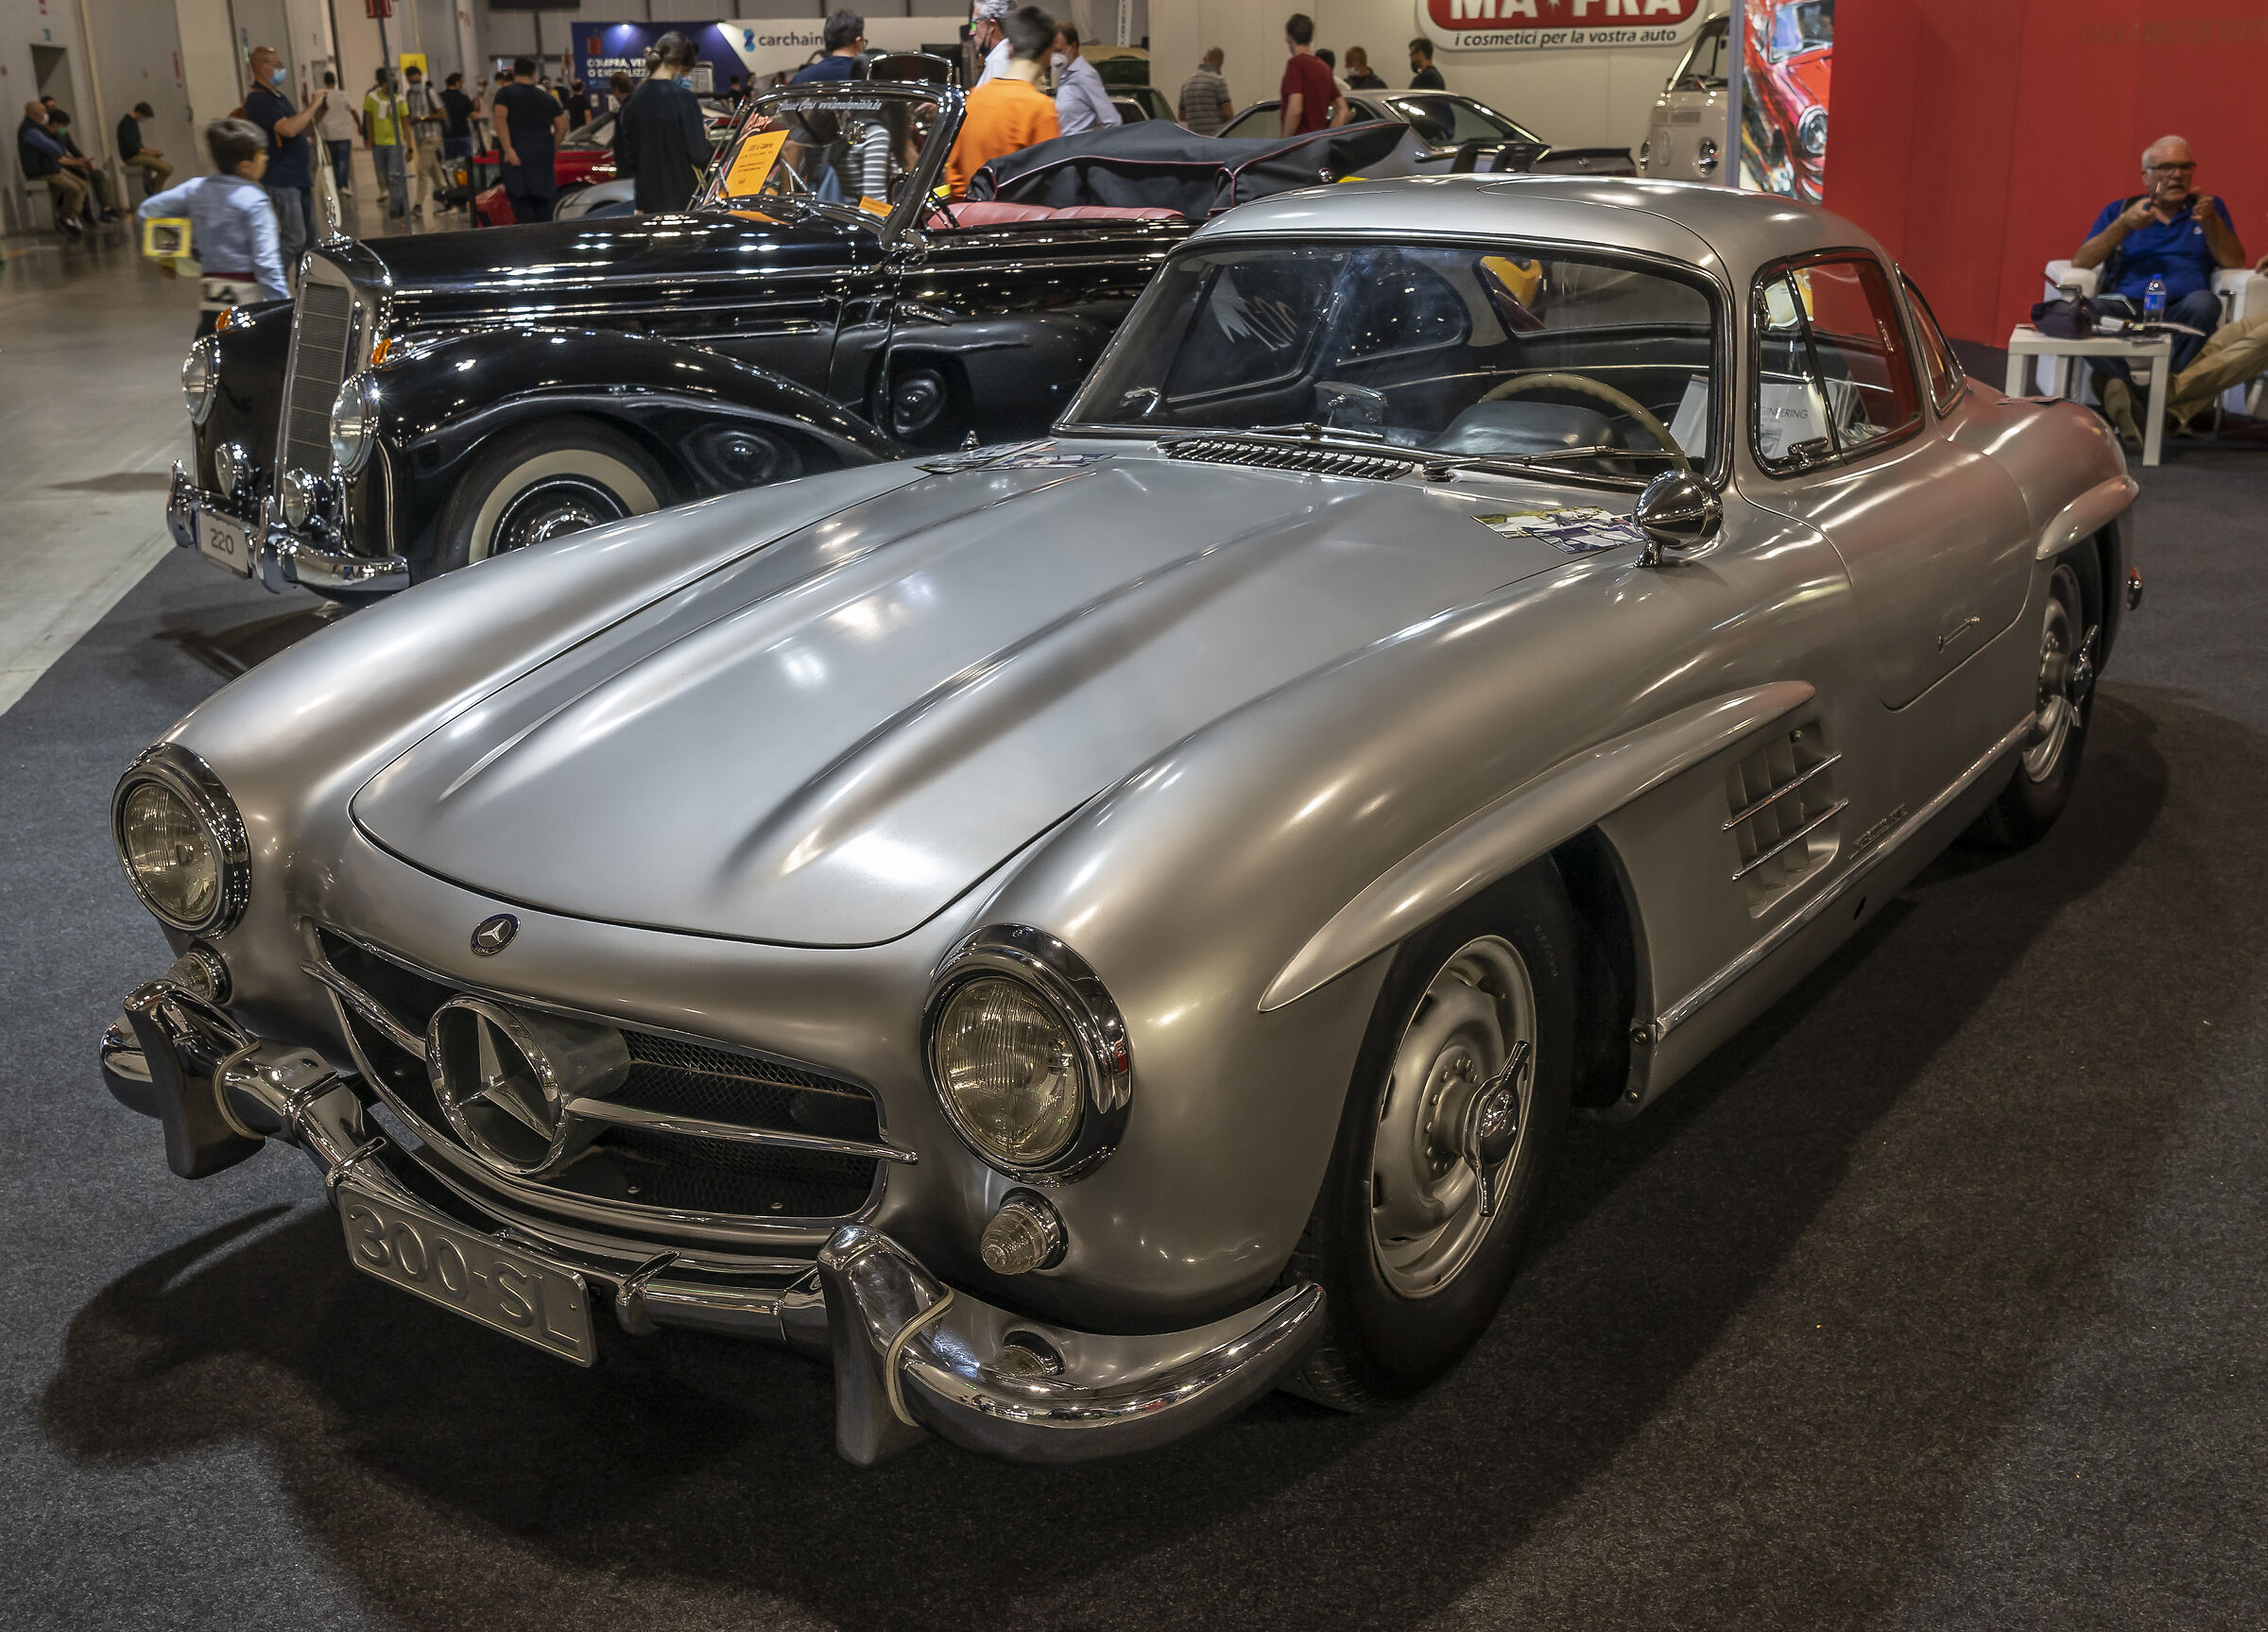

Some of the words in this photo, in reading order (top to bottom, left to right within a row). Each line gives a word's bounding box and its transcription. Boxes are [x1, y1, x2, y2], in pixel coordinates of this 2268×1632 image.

[759, 31, 824, 46] carchain
[1454, 33, 1460, 46] i
[1464, 31, 1537, 46] cosmetici
[1539, 33, 1567, 48] per
[1570, 30, 1584, 43] la
[1589, 30, 1636, 43] vostra
[1640, 30, 1676, 42] auto
[210, 527, 234, 555] 220
[350, 1203, 581, 1352] 300-SL
